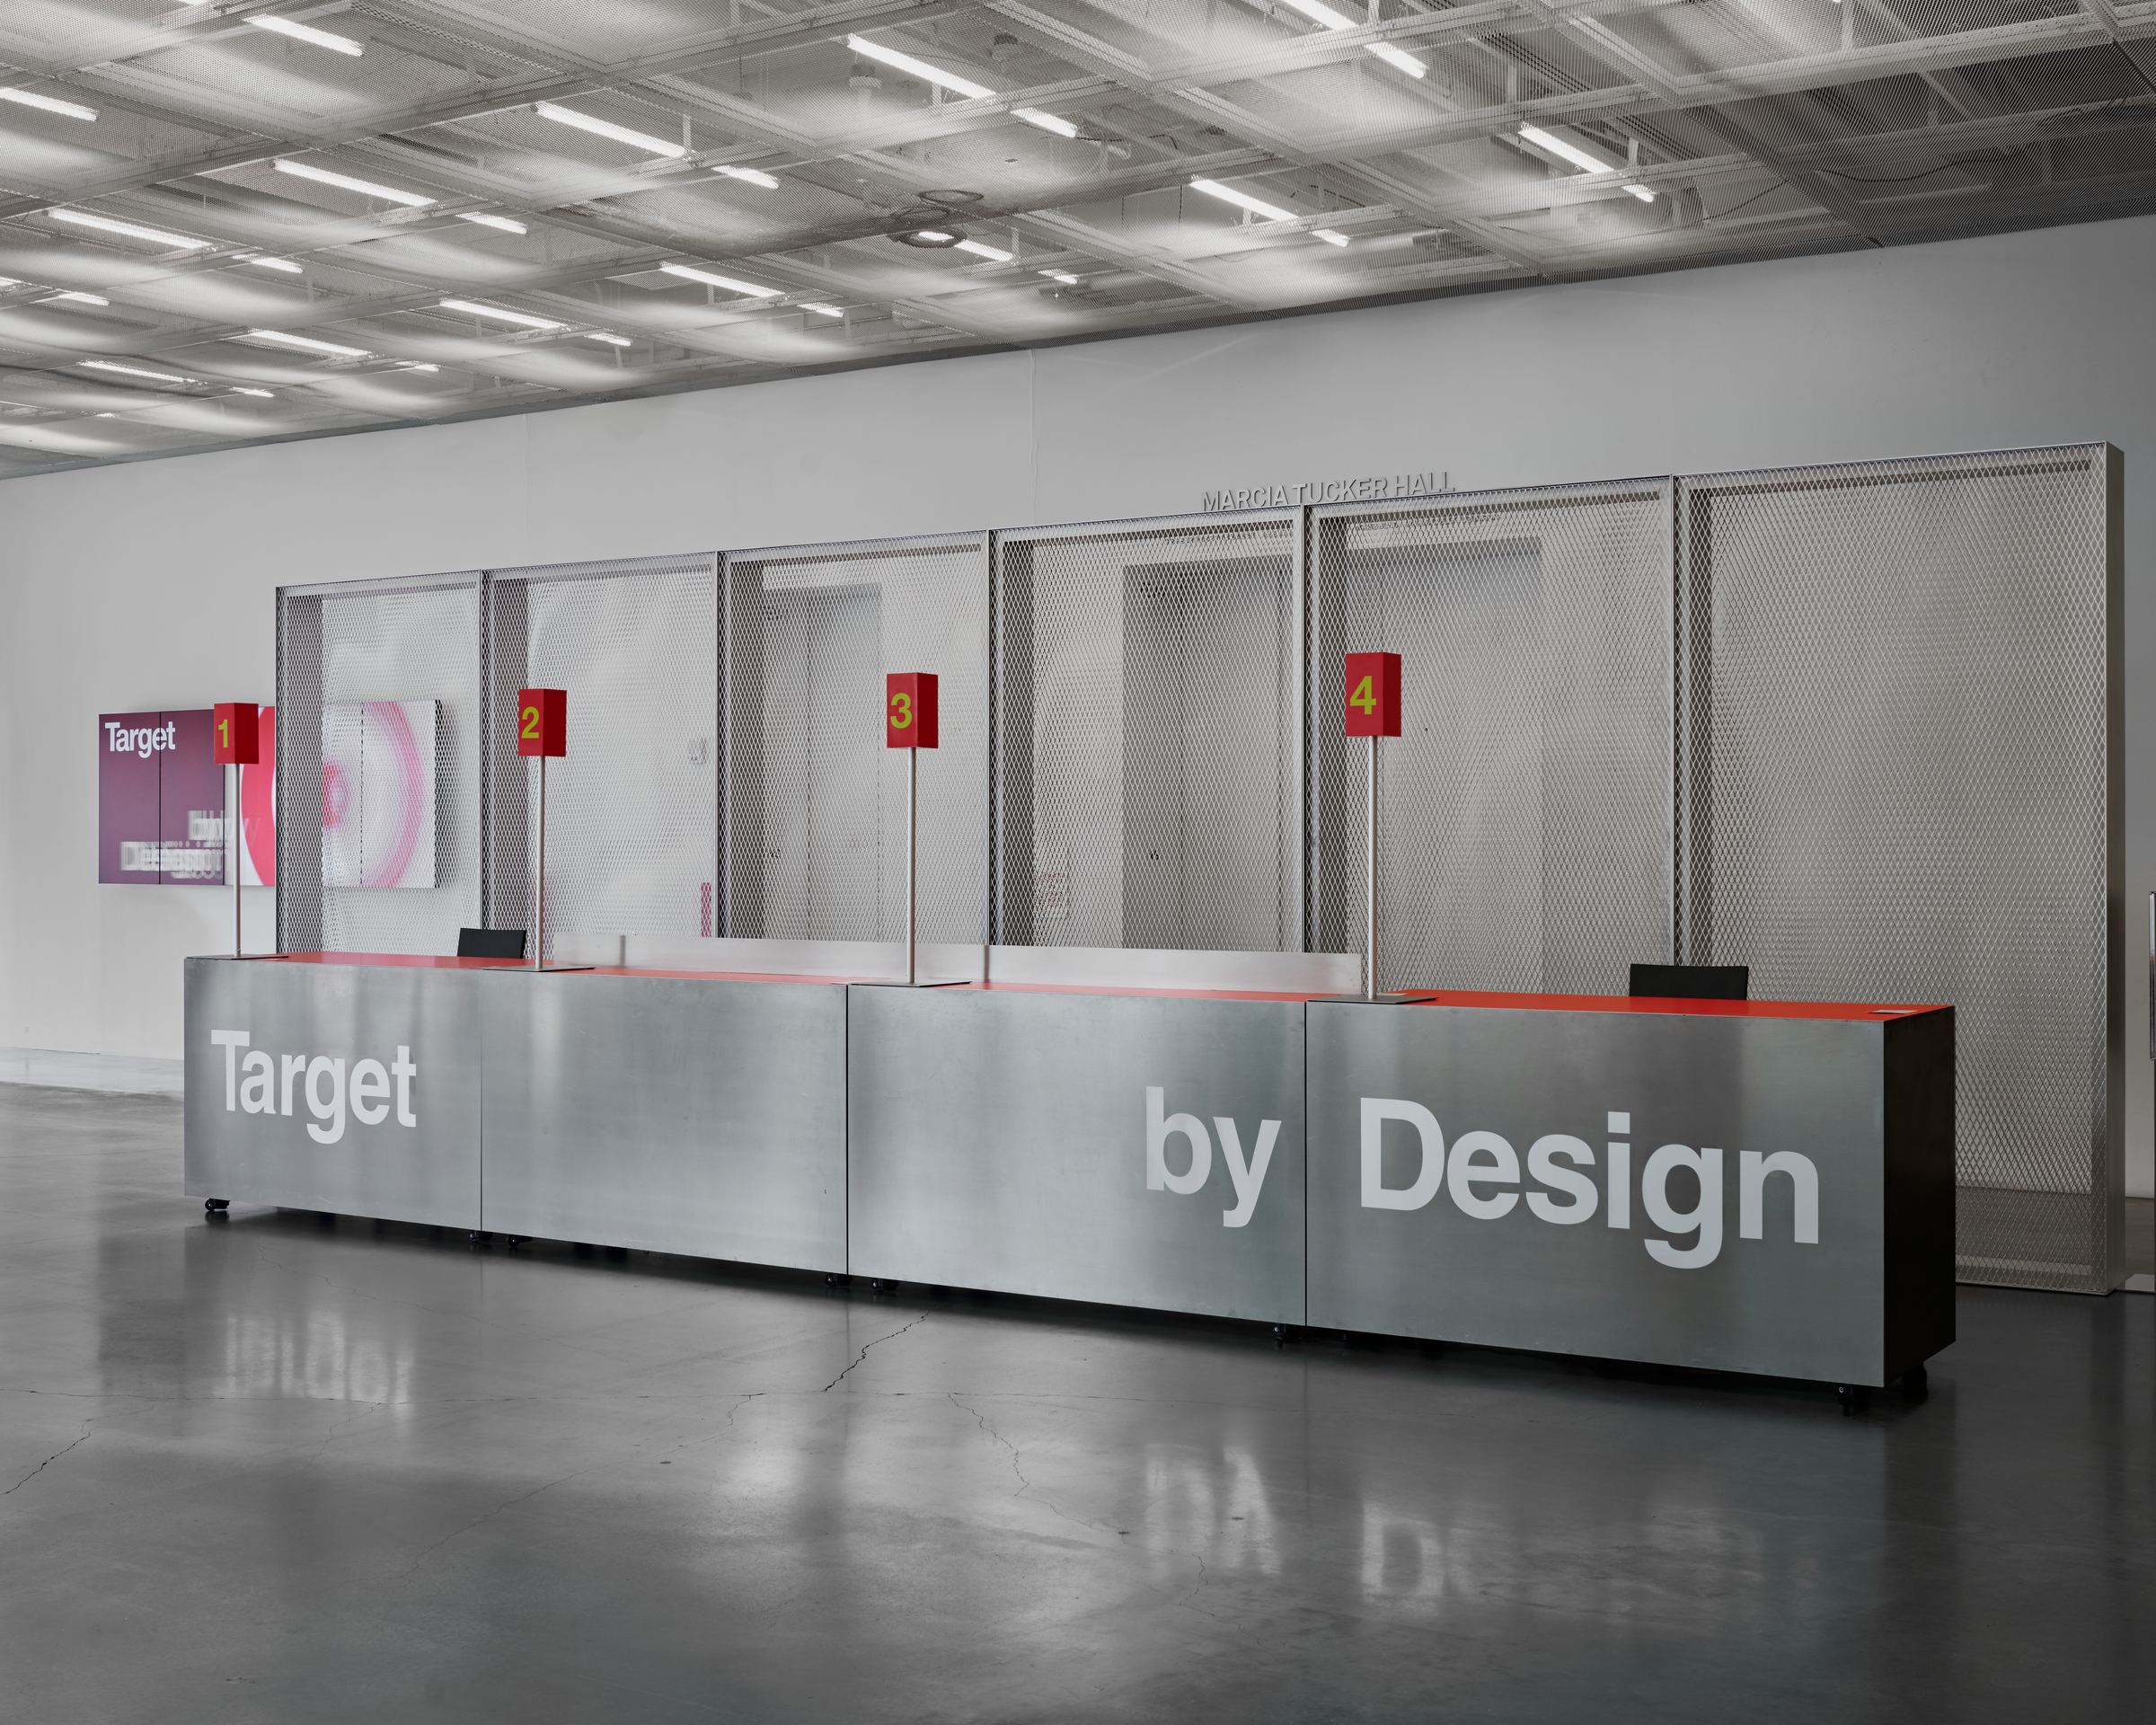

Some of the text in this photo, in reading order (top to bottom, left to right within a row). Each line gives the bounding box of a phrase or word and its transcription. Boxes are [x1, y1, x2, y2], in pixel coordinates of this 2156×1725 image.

[1201, 471, 1455, 511] MARCIA TUCKER HALL
[890, 692, 913, 730] 3
[1349, 675, 1377, 715] 4
[104, 721, 176, 758] Target
[217, 719, 229, 748] 1
[521, 706, 540, 739] 2
[211, 1030, 1818, 1269] Target by Design
